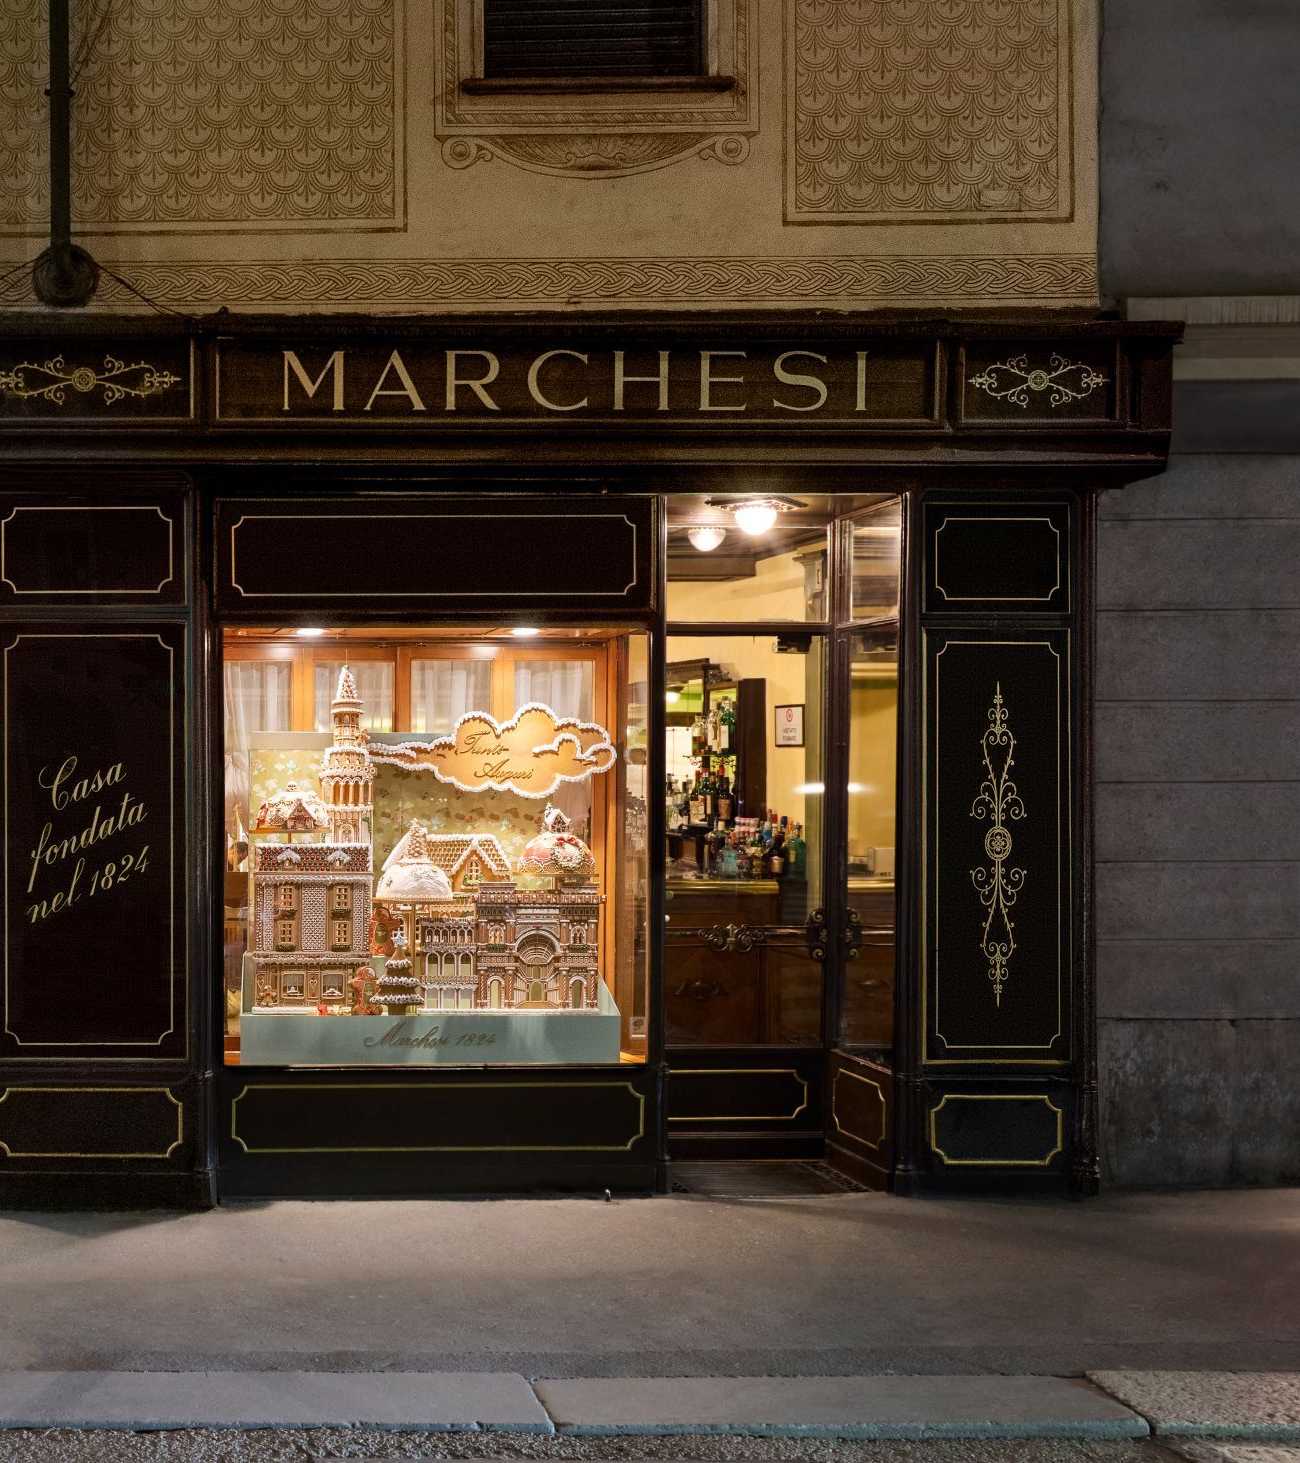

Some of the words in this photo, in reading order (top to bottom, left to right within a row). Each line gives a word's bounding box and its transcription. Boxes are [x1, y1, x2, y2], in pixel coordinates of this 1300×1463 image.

[282, 348, 870, 412] MARCHESI
[38, 755, 127, 811] Casa
[473, 758, 534, 785] Auguri
[26, 792, 148, 893] fondata
[26, 857, 86, 924] nel
[89, 845, 150, 897] 1824
[363, 1020, 452, 1049] Marchesi
[455, 1033, 498, 1047] 1824
